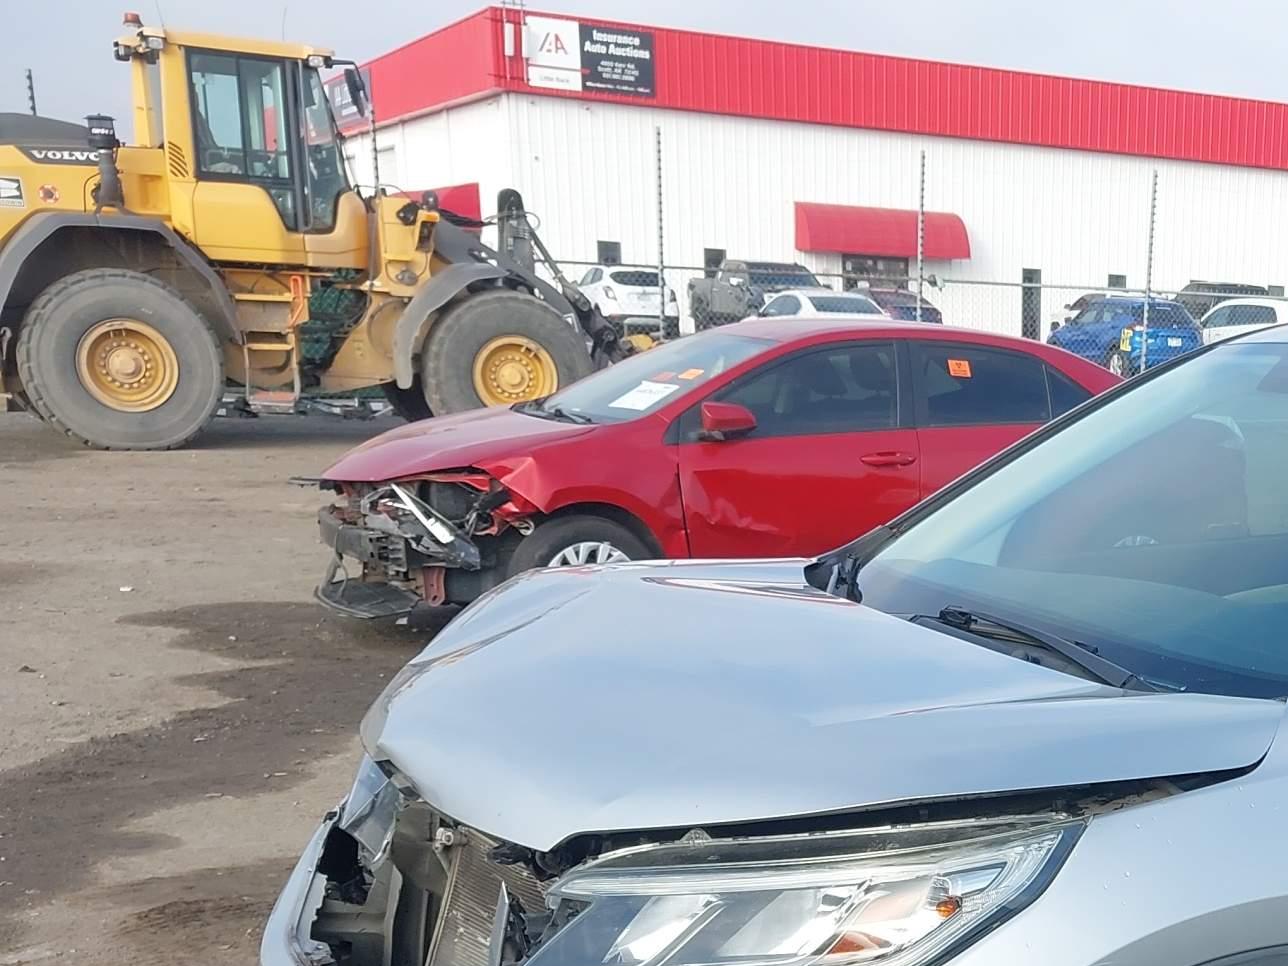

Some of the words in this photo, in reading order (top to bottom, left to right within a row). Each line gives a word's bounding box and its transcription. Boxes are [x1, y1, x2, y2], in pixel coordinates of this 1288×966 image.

[592, 29, 641, 46] Insurance
[584, 40, 607, 54] Auto
[608, 44, 650, 59] Auctions
